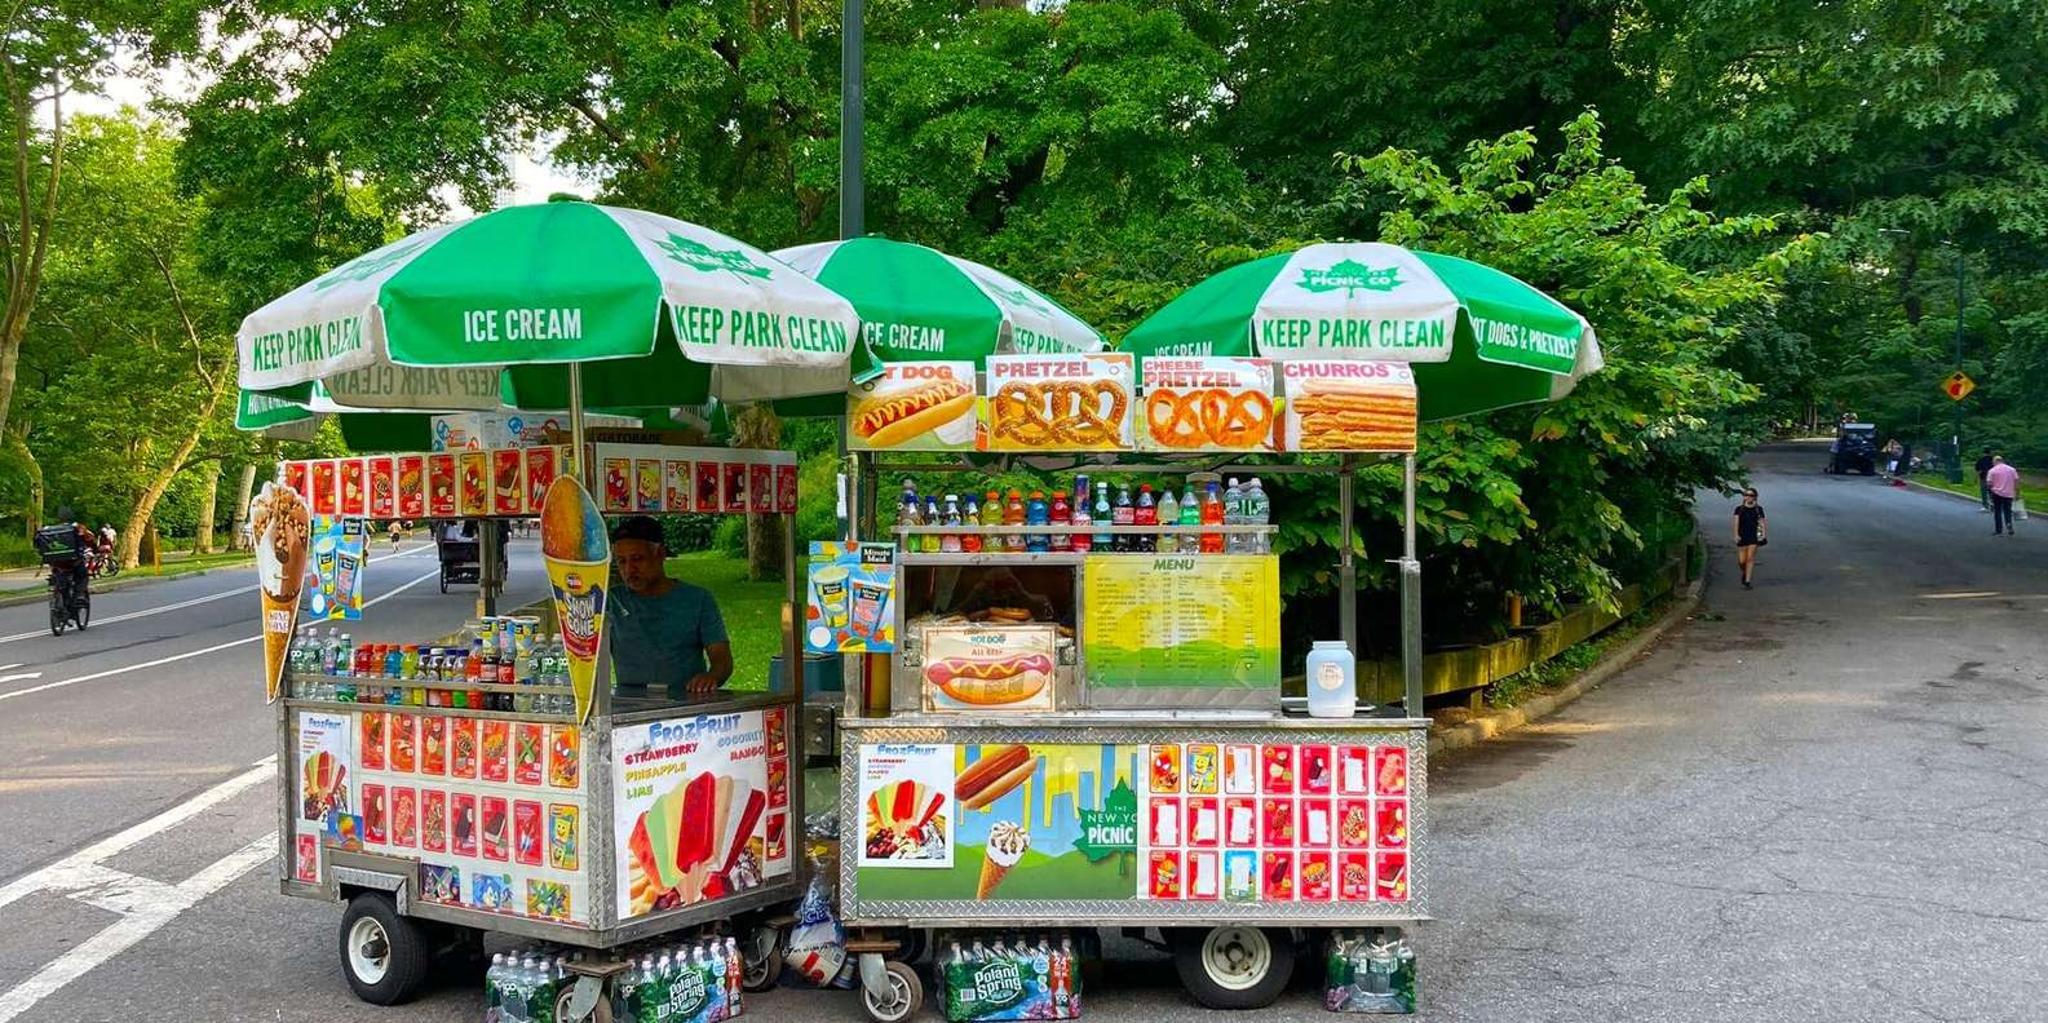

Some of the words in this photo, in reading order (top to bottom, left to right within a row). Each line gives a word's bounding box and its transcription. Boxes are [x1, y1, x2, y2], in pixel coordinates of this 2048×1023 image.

[463, 310, 499, 342] ICE
[505, 308, 582, 341] CREAM
[675, 305, 724, 345] KEEP
[731, 310, 785, 349] PARK
[788, 316, 847, 353] CLEAN
[1263, 319, 1312, 348] KEEP
[1318, 319, 1373, 348] PARK
[1379, 320, 1445, 348] CLEAN
[253, 332, 284, 371] KEEP
[287, 324, 323, 364] PARK
[327, 315, 364, 355] CLEAN
[864, 321, 884, 348] CE
[888, 324, 945, 352] CREAM
[1471, 317, 1485, 343] OT
[1487, 321, 1519, 348] DOGS
[1520, 326, 1528, 349] &
[1529, 329, 1578, 360] PRETZELS
[902, 366, 954, 380] DOG
[995, 361, 1094, 378] PRETZEL
[1143, 361, 1204, 371] CHEESE
[1283, 363, 1390, 379] CHURROS
[1143, 371, 1242, 388] PRETZEL
[1153, 559, 1195, 571] MENU
[717, 731, 764, 748] COCONUT
[624, 743, 699, 765] STRAWBERRY
[730, 745, 765, 761] MANGO
[625, 761, 687, 782] PINEAPPLE
[626, 785, 654, 800] LIME
[1088, 814, 1117, 823] NEW
[669, 971, 704, 998] Poland
[975, 964, 1019, 985] Poland
[671, 984, 705, 1014] Spring
[977, 979, 1022, 1001] Spring
